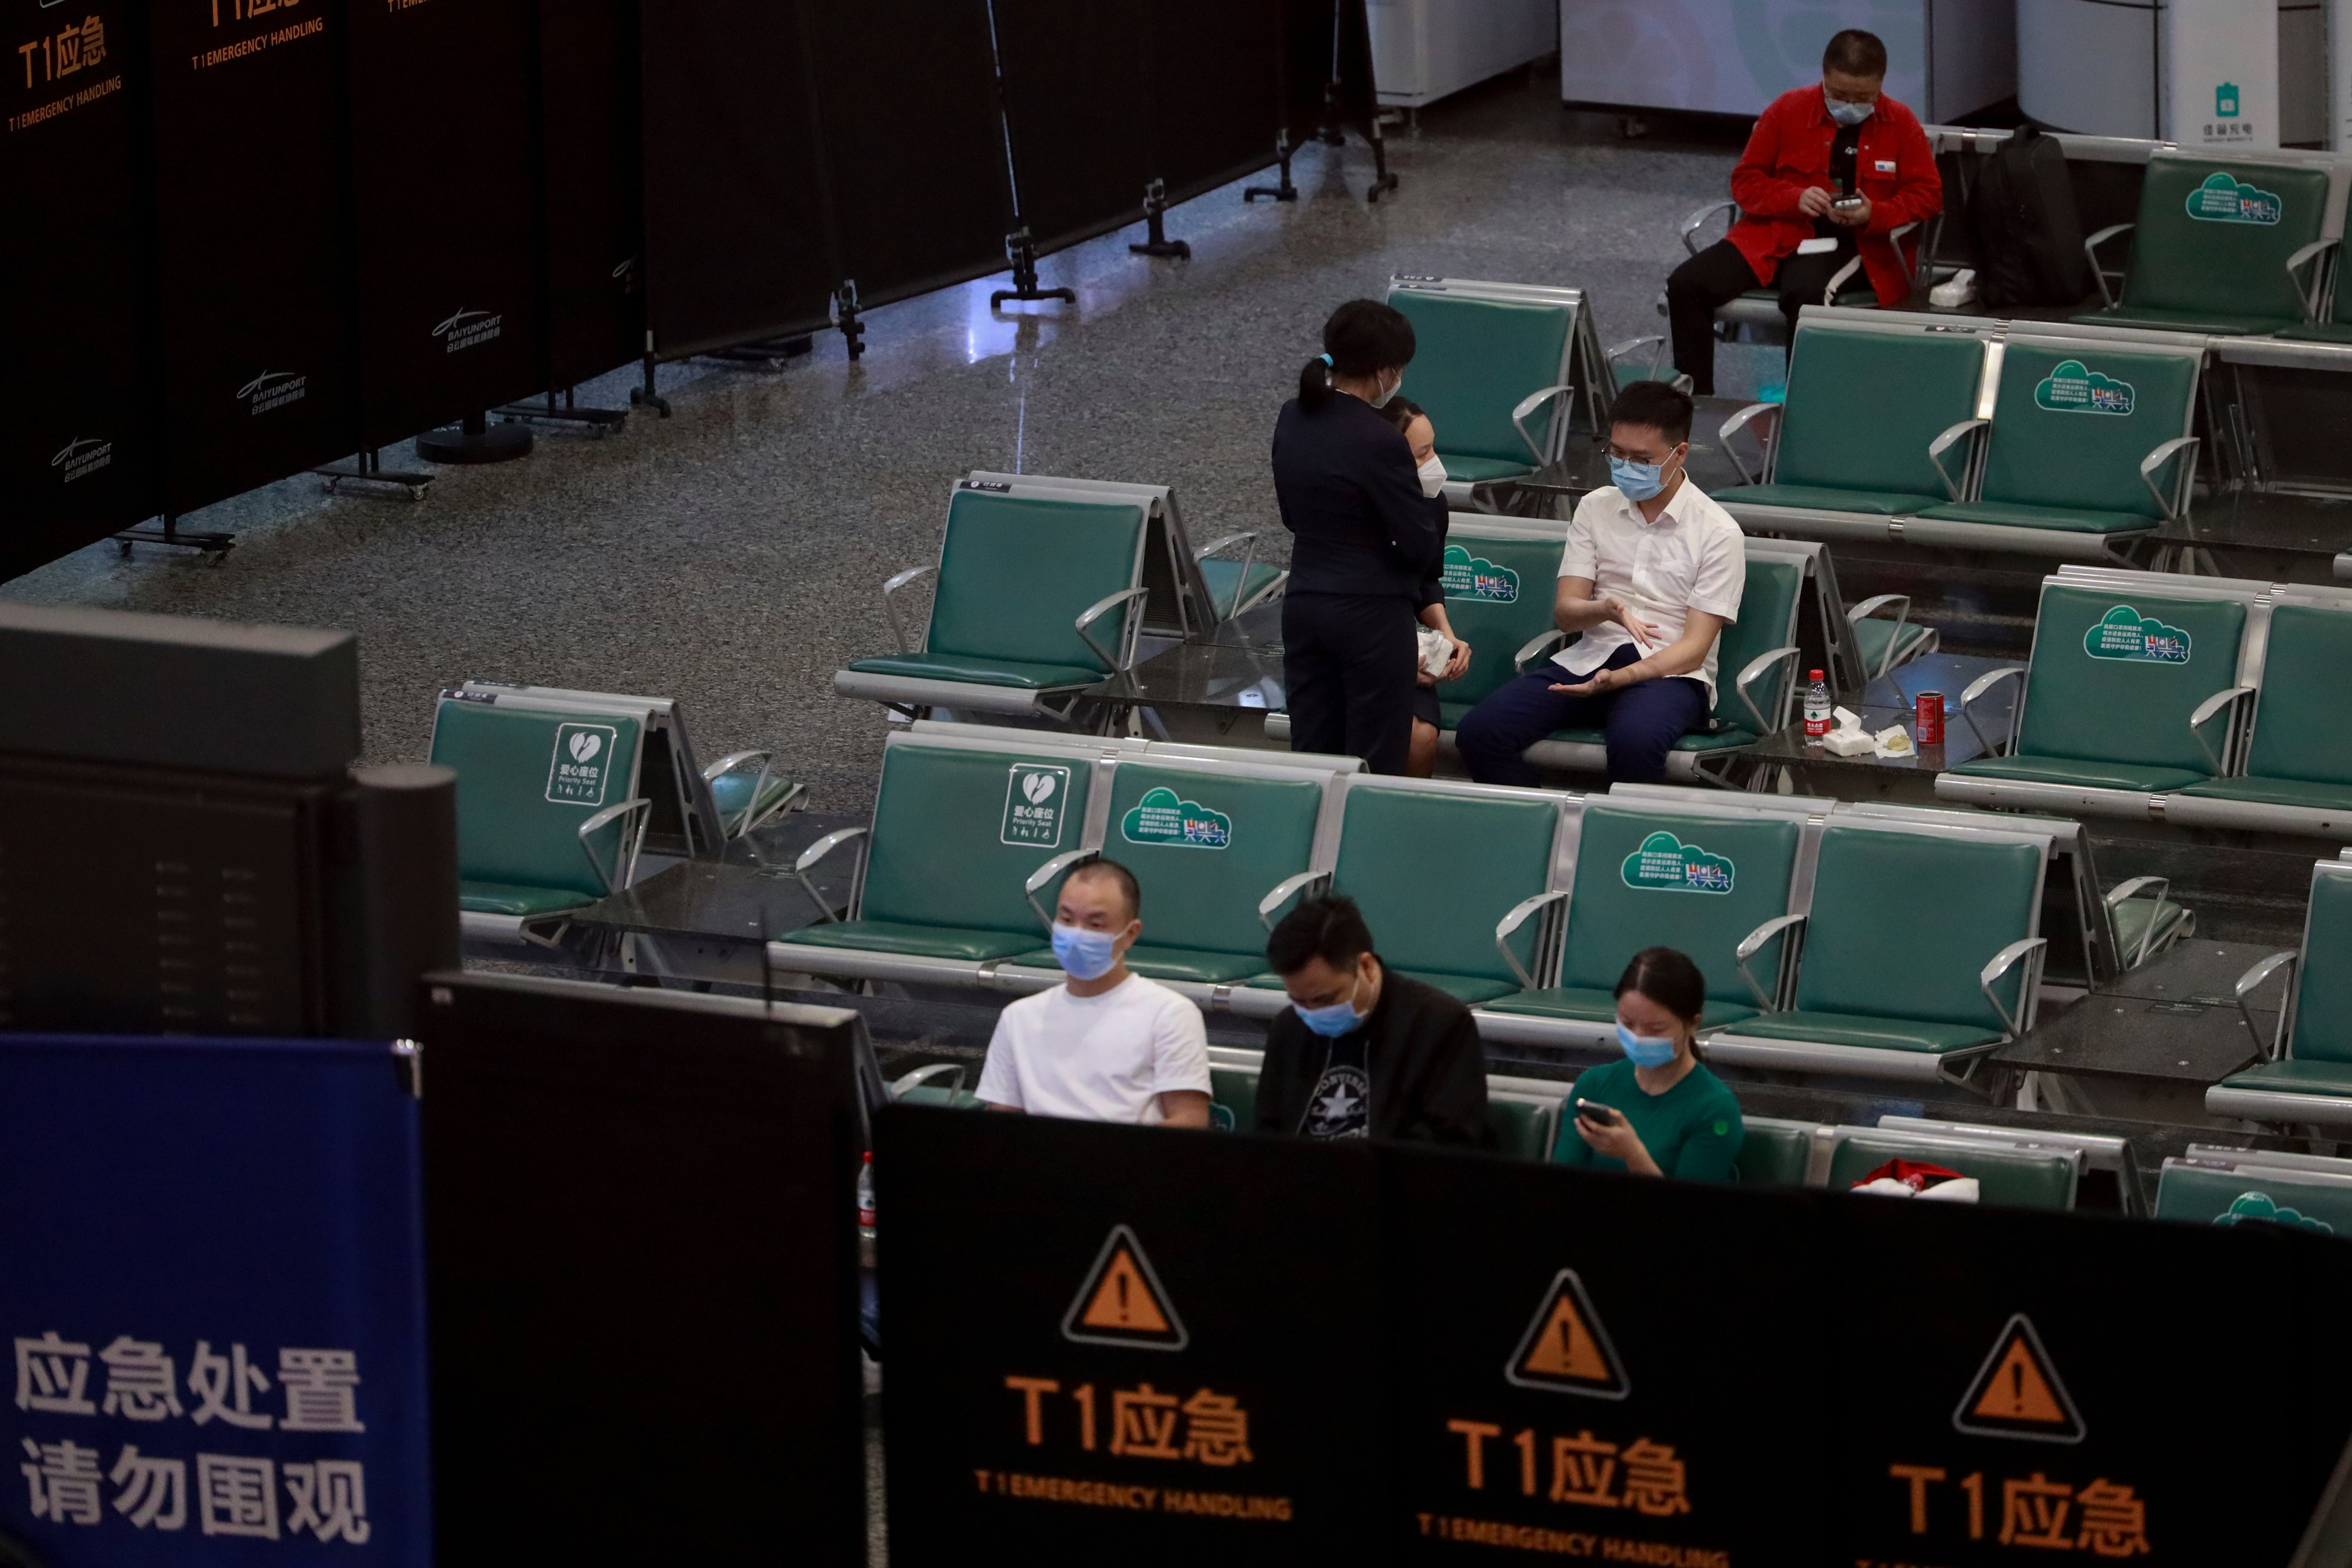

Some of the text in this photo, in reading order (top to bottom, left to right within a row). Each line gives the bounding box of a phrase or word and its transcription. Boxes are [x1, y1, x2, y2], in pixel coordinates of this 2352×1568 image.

[18, 15, 107, 89] T1应急
[207, 34, 268, 66] EMERGENCY
[271, 16, 323, 47] HANDLING
[22, 95, 74, 128] EMERGENCY
[76, 75, 121, 107] HANDLING
[447, 314, 502, 342] BAIYUNPORT
[252, 376, 306, 404] BAIYUNPORT
[64, 442, 112, 471] BAIYUNPORT
[558, 775, 581, 785] Priority
[559, 764, 599, 778] 爱心座位
[1012, 817, 1036, 827] Priority
[1014, 805, 1055, 820] 爱心座位
[12, 1330, 366, 1434] 应急处置
[1003, 1374, 1255, 1468] T1应急
[19, 1436, 372, 1546] 请勿围观
[1446, 1417, 1693, 1518] T1应急
[1009, 1472, 1159, 1510] EMERGENCY
[1162, 1488, 1294, 1522] HANDLING
[1888, 1461, 2153, 1559] T1应急
[1451, 1516, 1599, 1557] EMERGENCY
[1602, 1536, 1732, 1568] HANDLING
